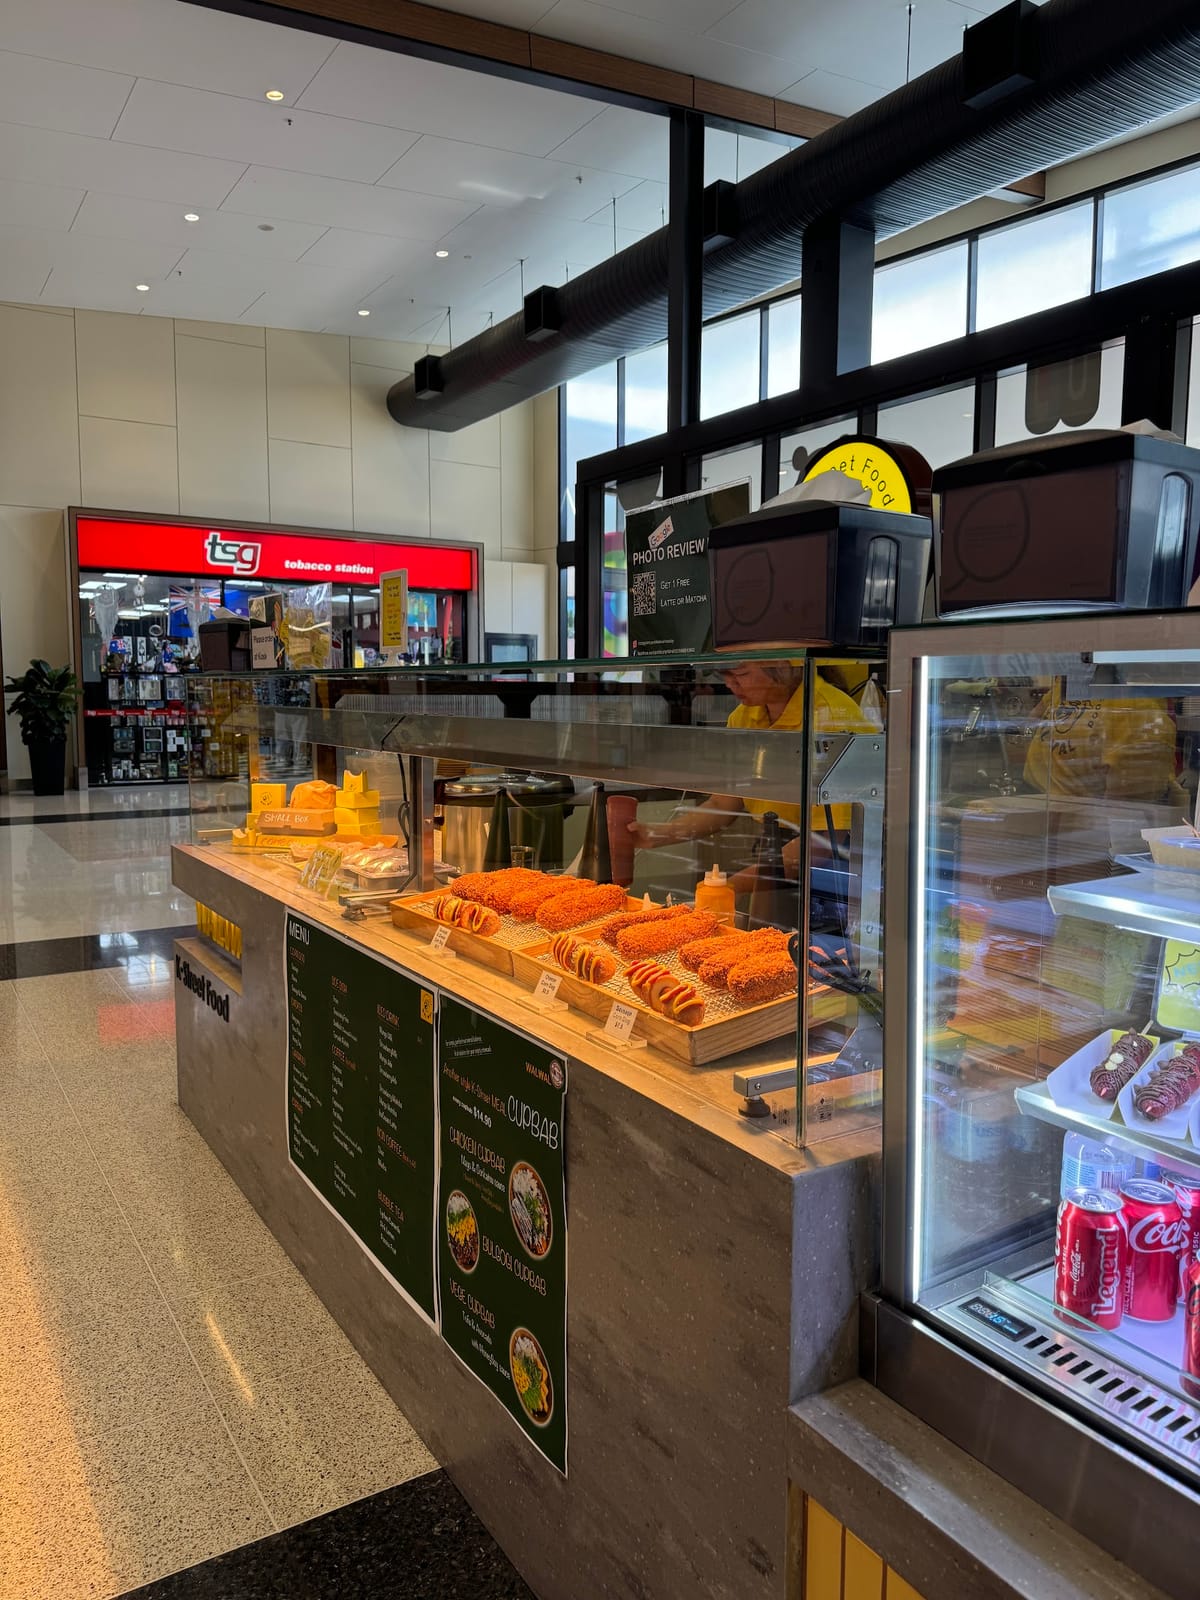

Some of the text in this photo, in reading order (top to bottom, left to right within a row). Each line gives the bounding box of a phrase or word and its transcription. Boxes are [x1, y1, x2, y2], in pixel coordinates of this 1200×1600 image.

[862, 458, 895, 506] Food
[206, 533, 260, 574] tsg
[633, 537, 705, 566] PHOTO REVIEW
[650, 523, 672, 546] Google
[284, 560, 374, 575] tobacco station
[264, 813, 290, 824] SMALL
[289, 920, 310, 945] MENU
[176, 954, 230, 1023] K-Street Food
[526, 1061, 552, 1086] WALWAL
[491, 1094, 507, 1117] MEAL
[508, 1095, 559, 1150] CUPBAB
[449, 1126, 506, 1174] CHICKEN CUPBAB
[482, 1235, 547, 1297] BULGOGI CUPBAB
[1091, 1224, 1121, 1315] Legend
[449, 1277, 496, 1329] VEGE CUPBAB
